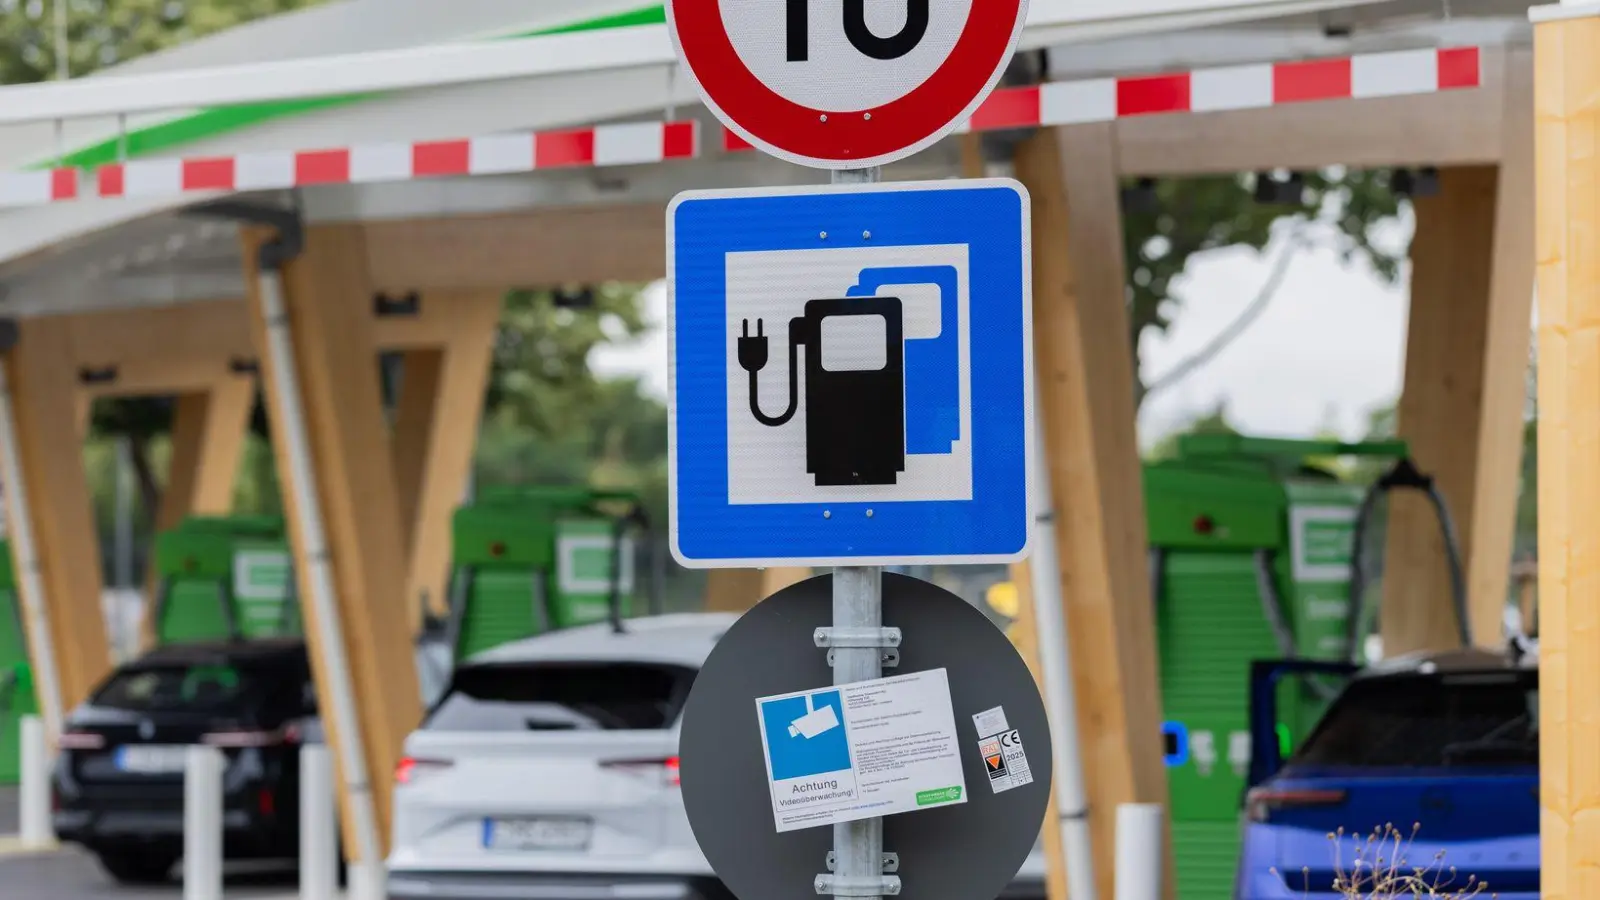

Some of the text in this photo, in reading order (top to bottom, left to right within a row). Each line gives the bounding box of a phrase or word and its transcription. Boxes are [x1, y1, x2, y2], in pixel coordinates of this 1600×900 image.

[1002, 731, 1020, 747] CE
[1006, 752, 1024, 762] 2025
[792, 779, 838, 794] Achtung
[780, 788, 853, 807] Videoüberwachung!
